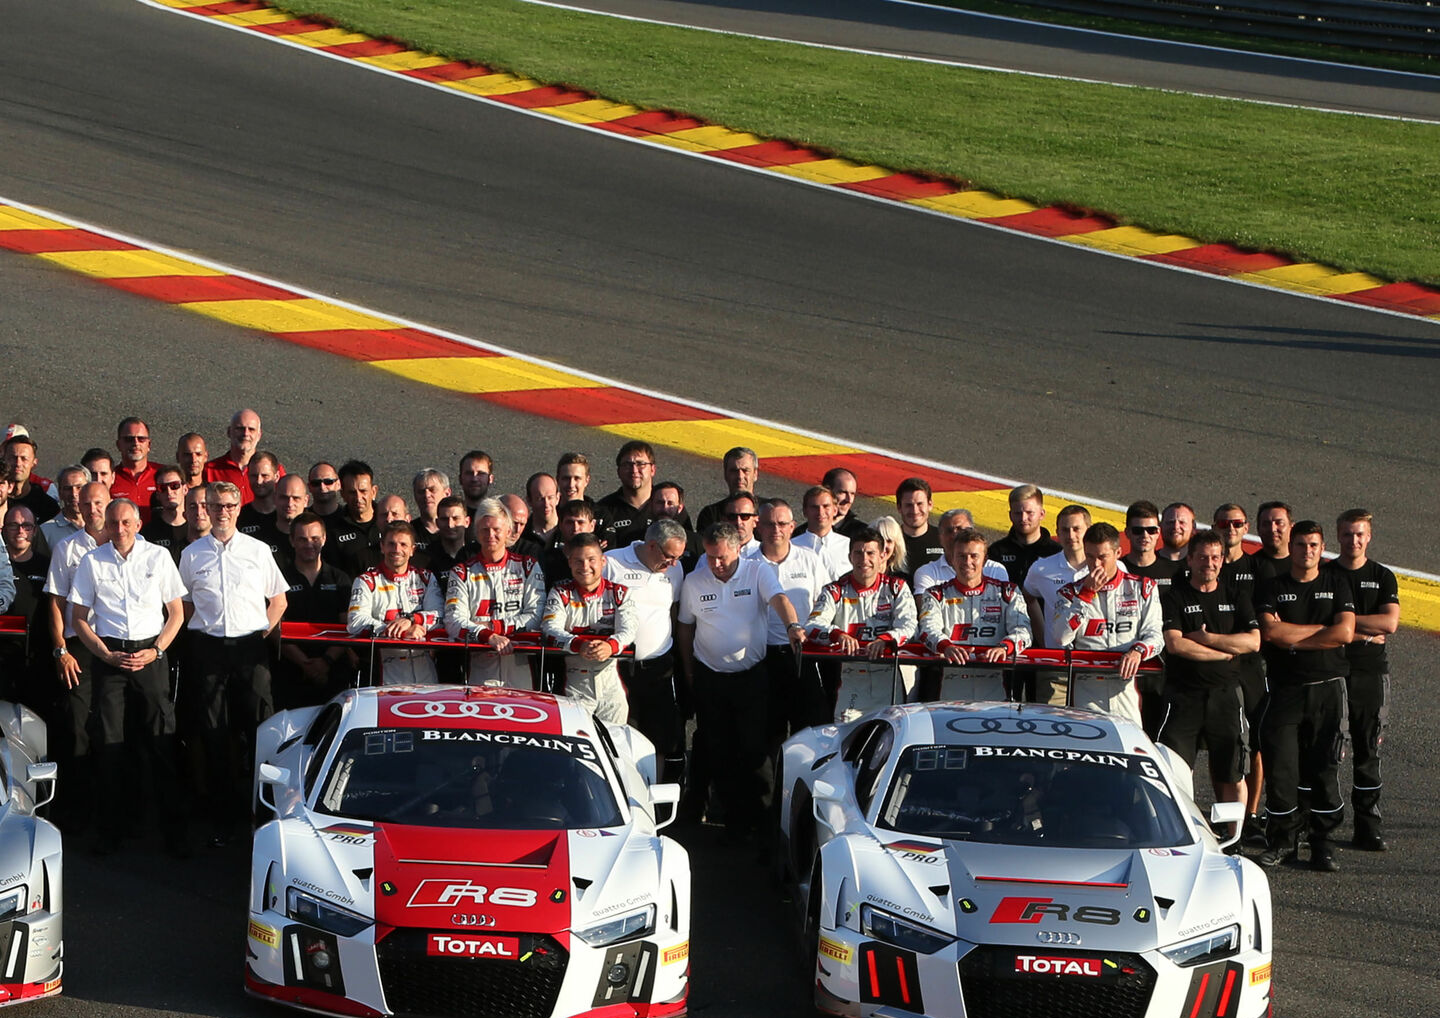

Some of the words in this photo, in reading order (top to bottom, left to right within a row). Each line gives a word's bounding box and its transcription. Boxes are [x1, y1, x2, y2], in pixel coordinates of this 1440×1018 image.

[487, 600, 520, 613] R8
[959, 626, 996, 638] R8
[1094, 620, 1133, 634] R8
[422, 730, 574, 753] BLANCPAIN
[577, 743, 596, 760] 5
[973, 746, 1129, 768] BLANCPAIN
[1139, 761, 1159, 778] 6
[332, 833, 366, 846] PRO
[902, 852, 938, 864] PRO
[0, 872, 26, 887] GmbH
[292, 877, 324, 894] quattro
[325, 890, 355, 906] GmbH
[430, 882, 538, 908] R8
[592, 902, 626, 917] quattro
[626, 892, 652, 906] GmbH
[866, 894, 901, 911] quattro
[903, 907, 935, 923] GmbH
[1013, 900, 1121, 926] R8
[1177, 922, 1211, 937] quattro
[1211, 912, 1236, 927] GmbH
[432, 936, 512, 956] TOTAL
[1017, 955, 1098, 975] TOTAL
